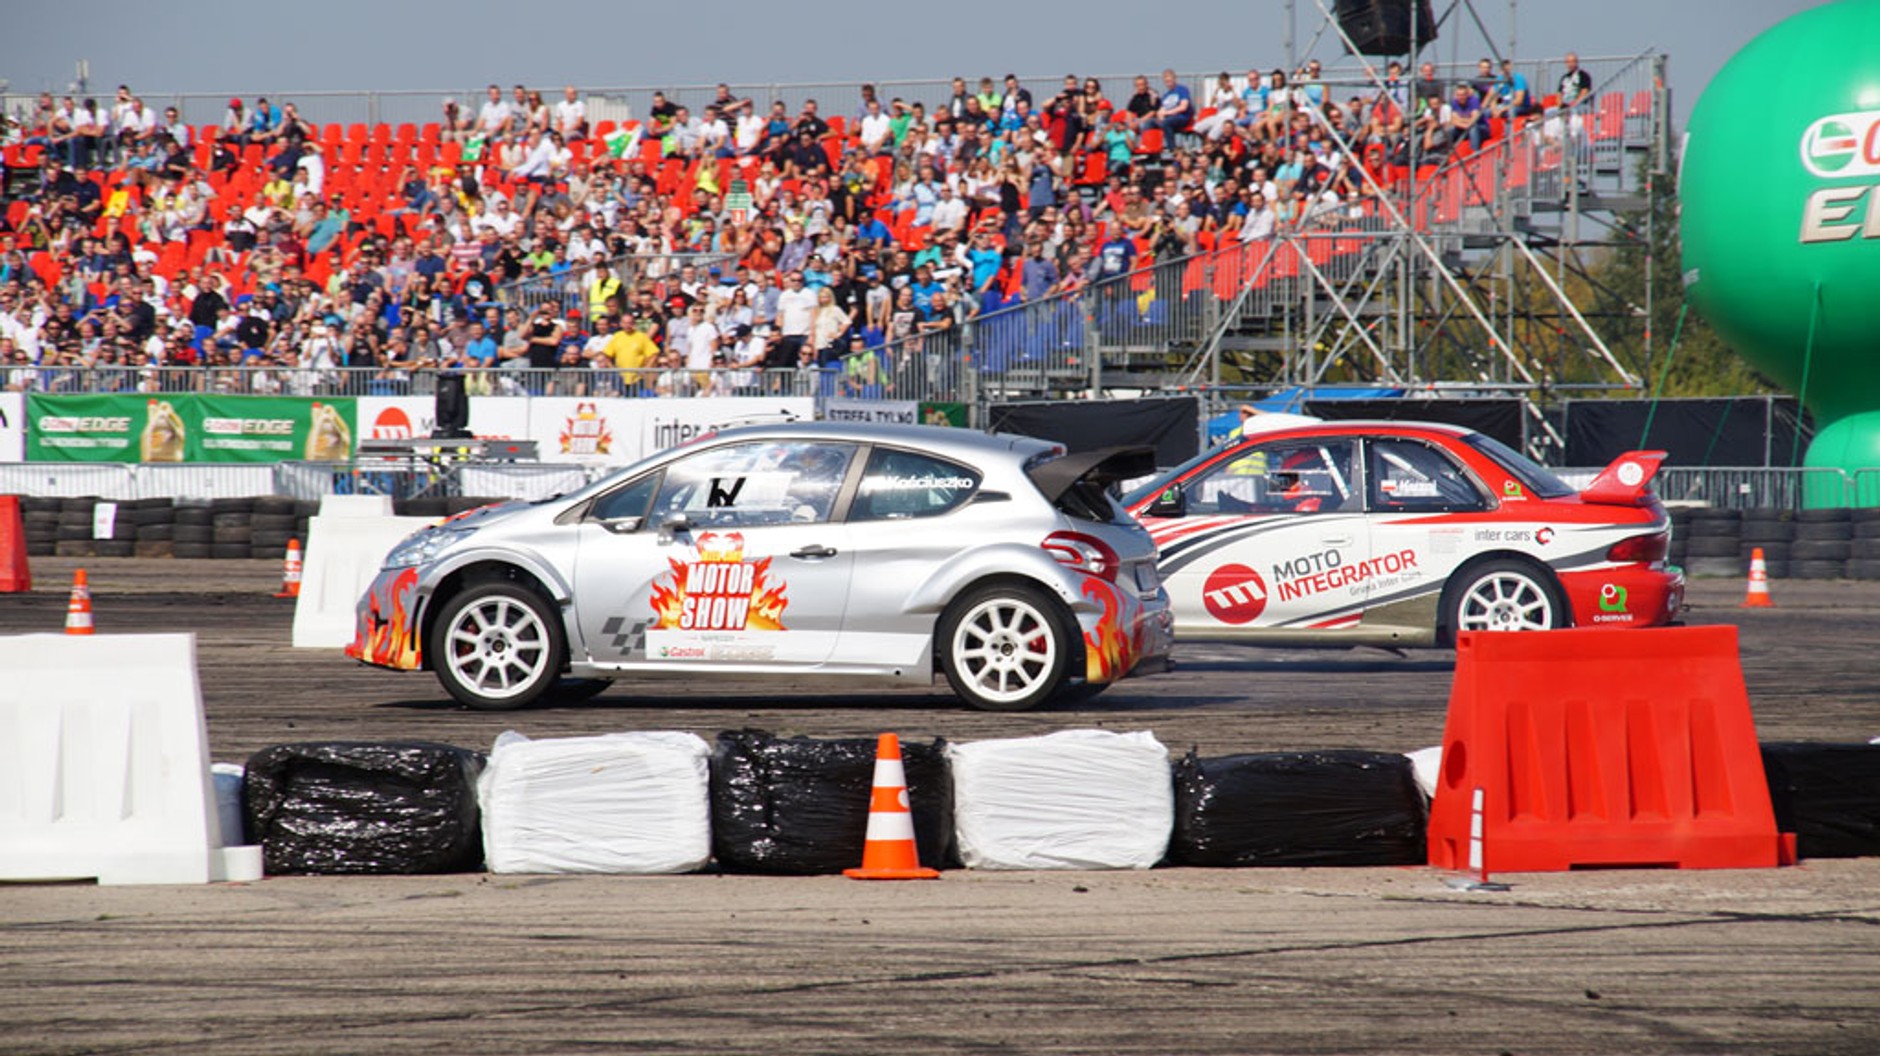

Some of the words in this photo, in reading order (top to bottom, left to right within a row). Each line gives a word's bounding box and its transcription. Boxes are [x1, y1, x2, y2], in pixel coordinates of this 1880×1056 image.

[76, 416, 132, 432] EDGE
[243, 418, 294, 434] EDGE
[1475, 529, 1501, 541] inter
[1504, 530, 1530, 541] cars
[685, 562, 755, 595] MOTOR
[1272, 549, 1342, 583] MOTO
[1277, 549, 1418, 602] INTEGRATOR
[680, 596, 749, 630] SHOW
